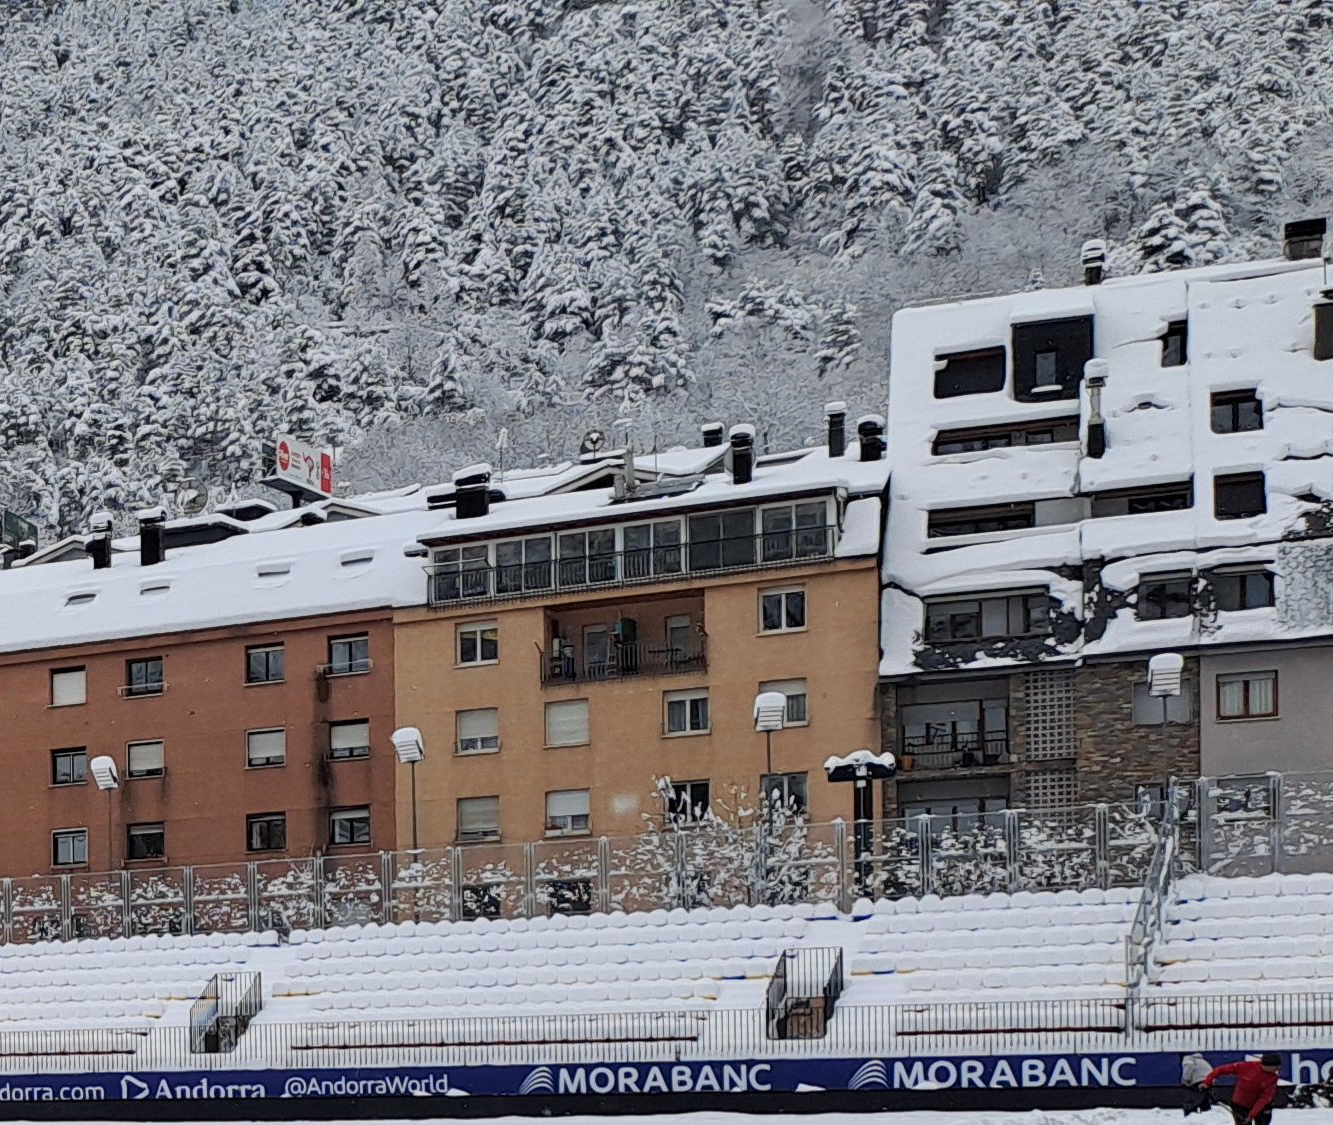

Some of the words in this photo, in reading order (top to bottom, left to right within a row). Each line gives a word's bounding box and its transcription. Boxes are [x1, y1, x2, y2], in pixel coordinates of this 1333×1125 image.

[157, 1077, 266, 1099] Andorra
[285, 1073, 449, 1096] @AndorraWorld
[558, 1063, 772, 1094] MORABANC
[893, 1056, 1137, 1089] MORABANC
